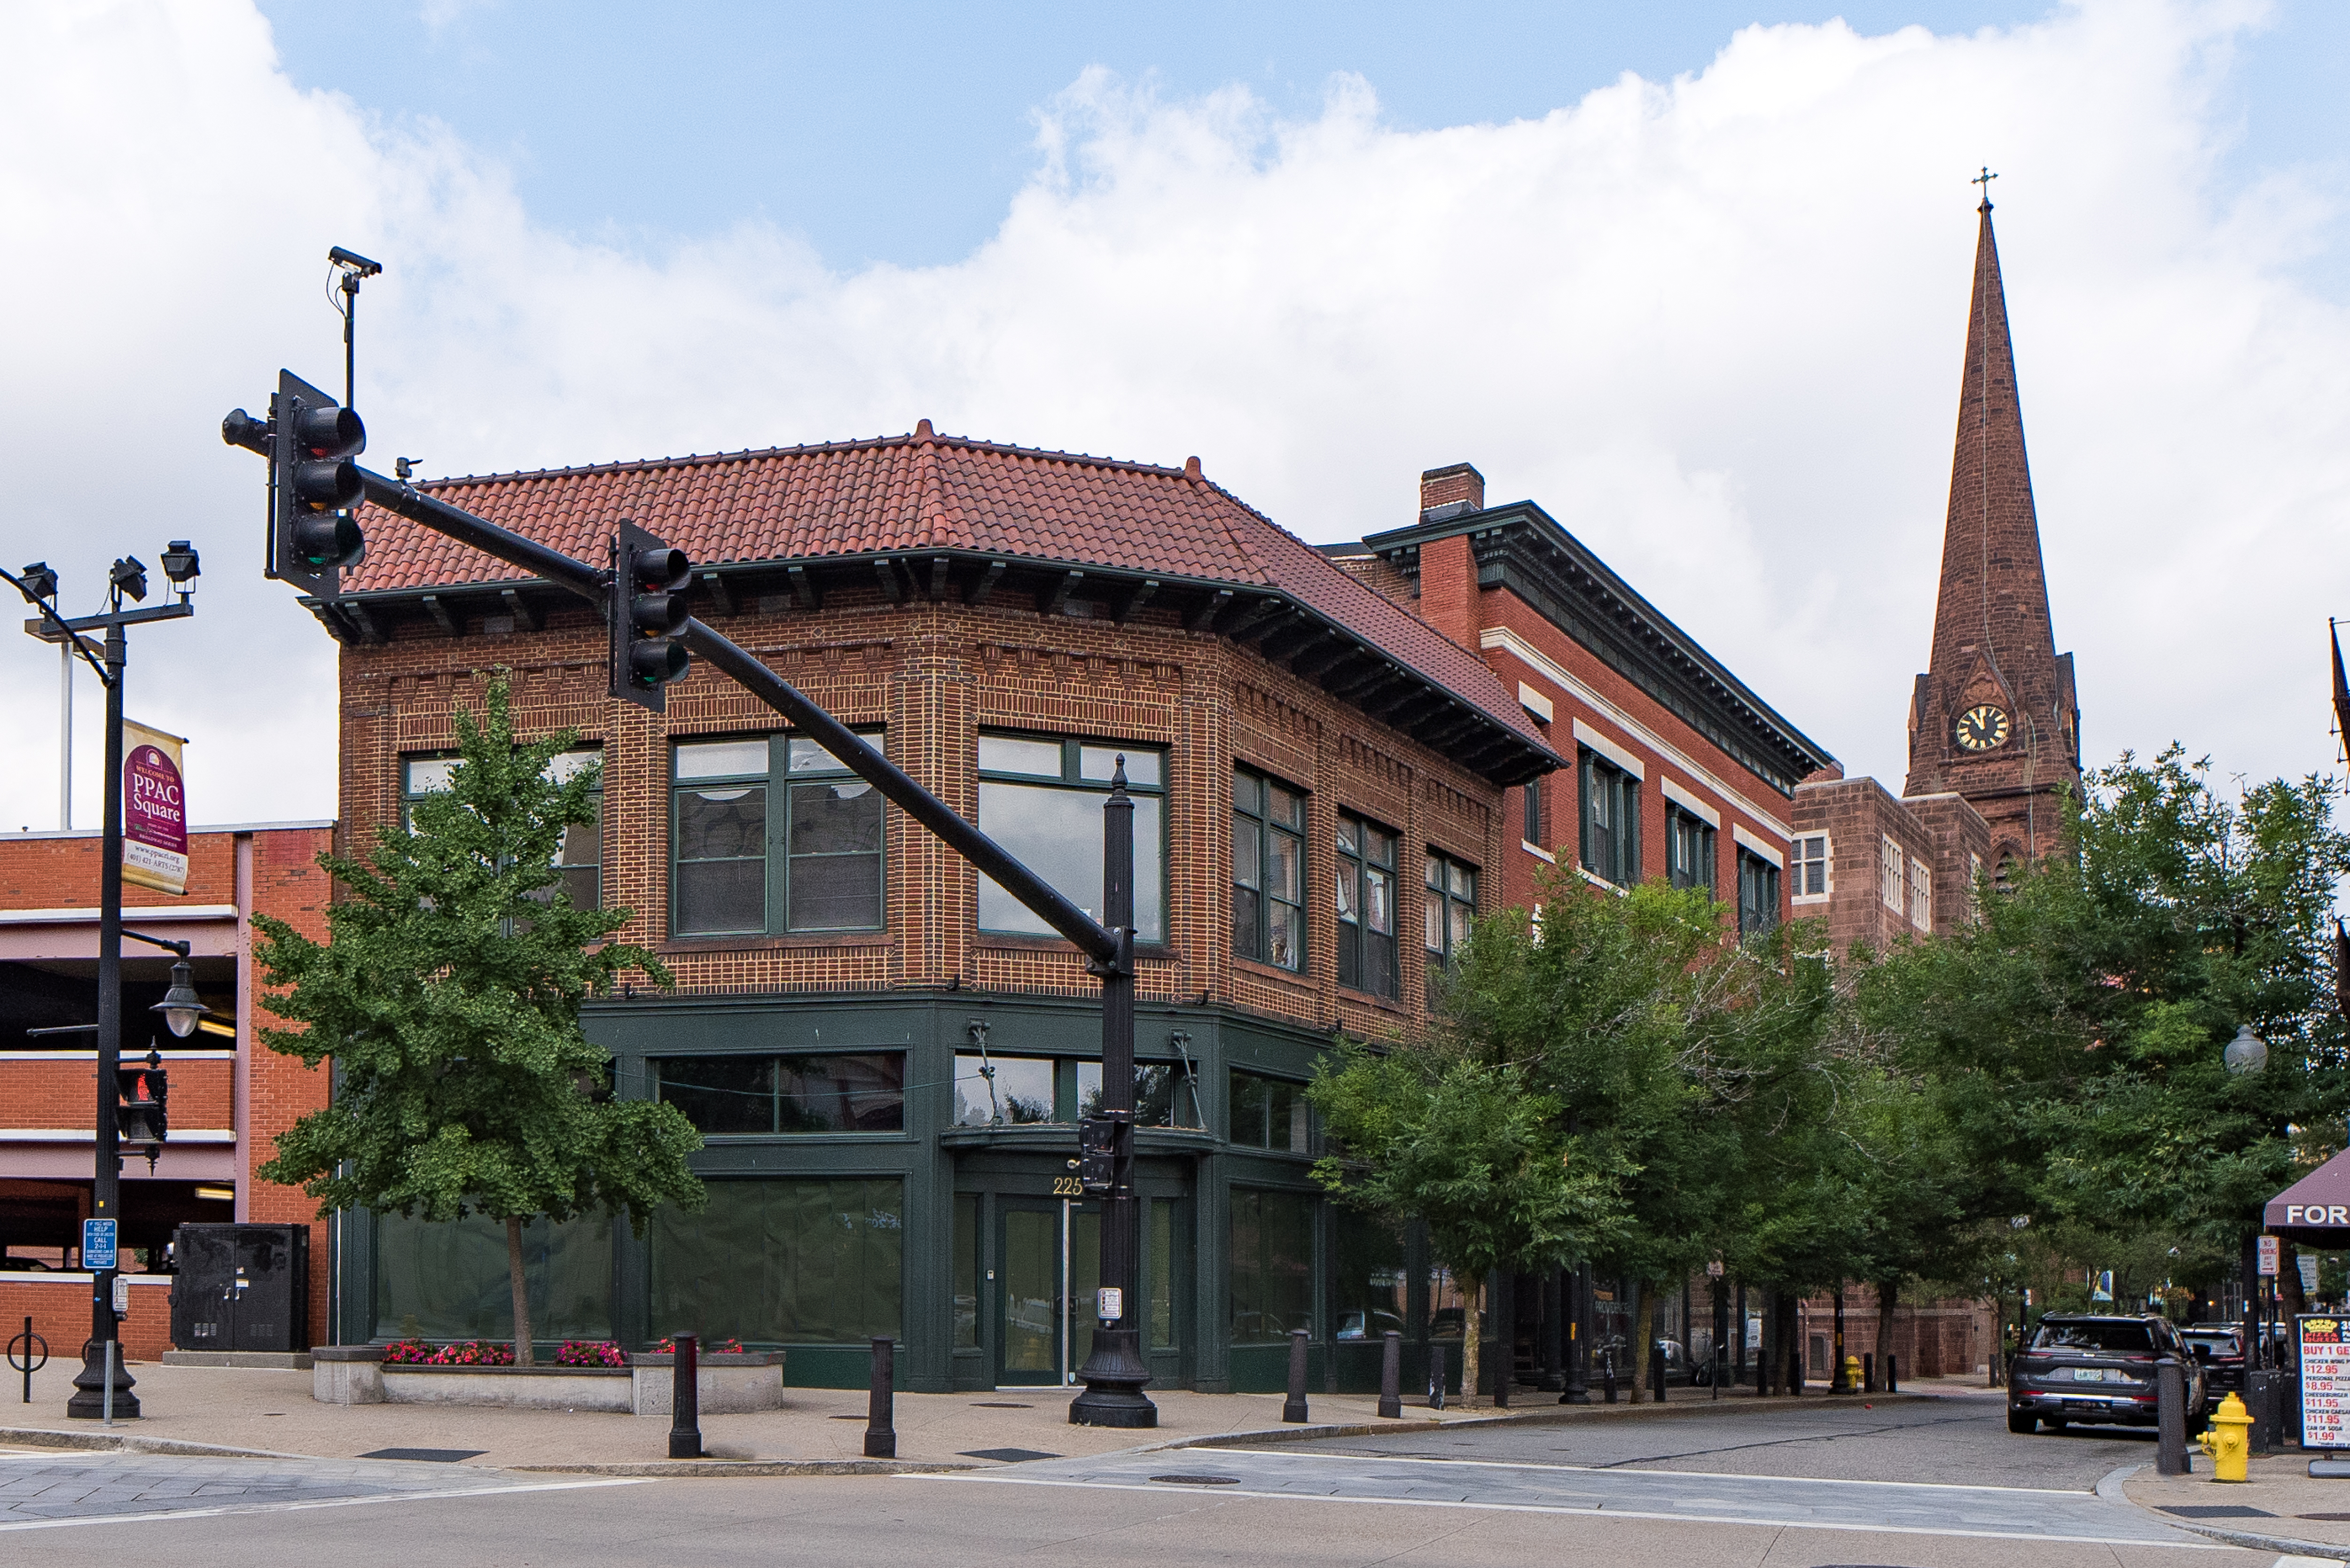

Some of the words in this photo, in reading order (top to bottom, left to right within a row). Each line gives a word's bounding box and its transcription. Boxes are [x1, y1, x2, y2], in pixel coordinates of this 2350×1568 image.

[136, 765, 165, 780] WELCOME
[132, 772, 179, 805] PPAC
[133, 793, 180, 822] Square
[127, 852, 141, 863] (401)
[1053, 1177, 1082, 1195] 225
[2287, 1205, 2349, 1224] FOR
[2303, 1346, 2324, 1355] BUY
[2327, 1346, 2333, 1355] 1
[2336, 1345, 2350, 1355] GE
[2305, 1364, 2338, 1374] $12.95
[2305, 1381, 2333, 1391] $8.95
[2305, 1398, 2339, 1408] $11.95
[2307, 1414, 2340, 1424] $11.95
[2308, 1431, 2334, 1441] $1.99
